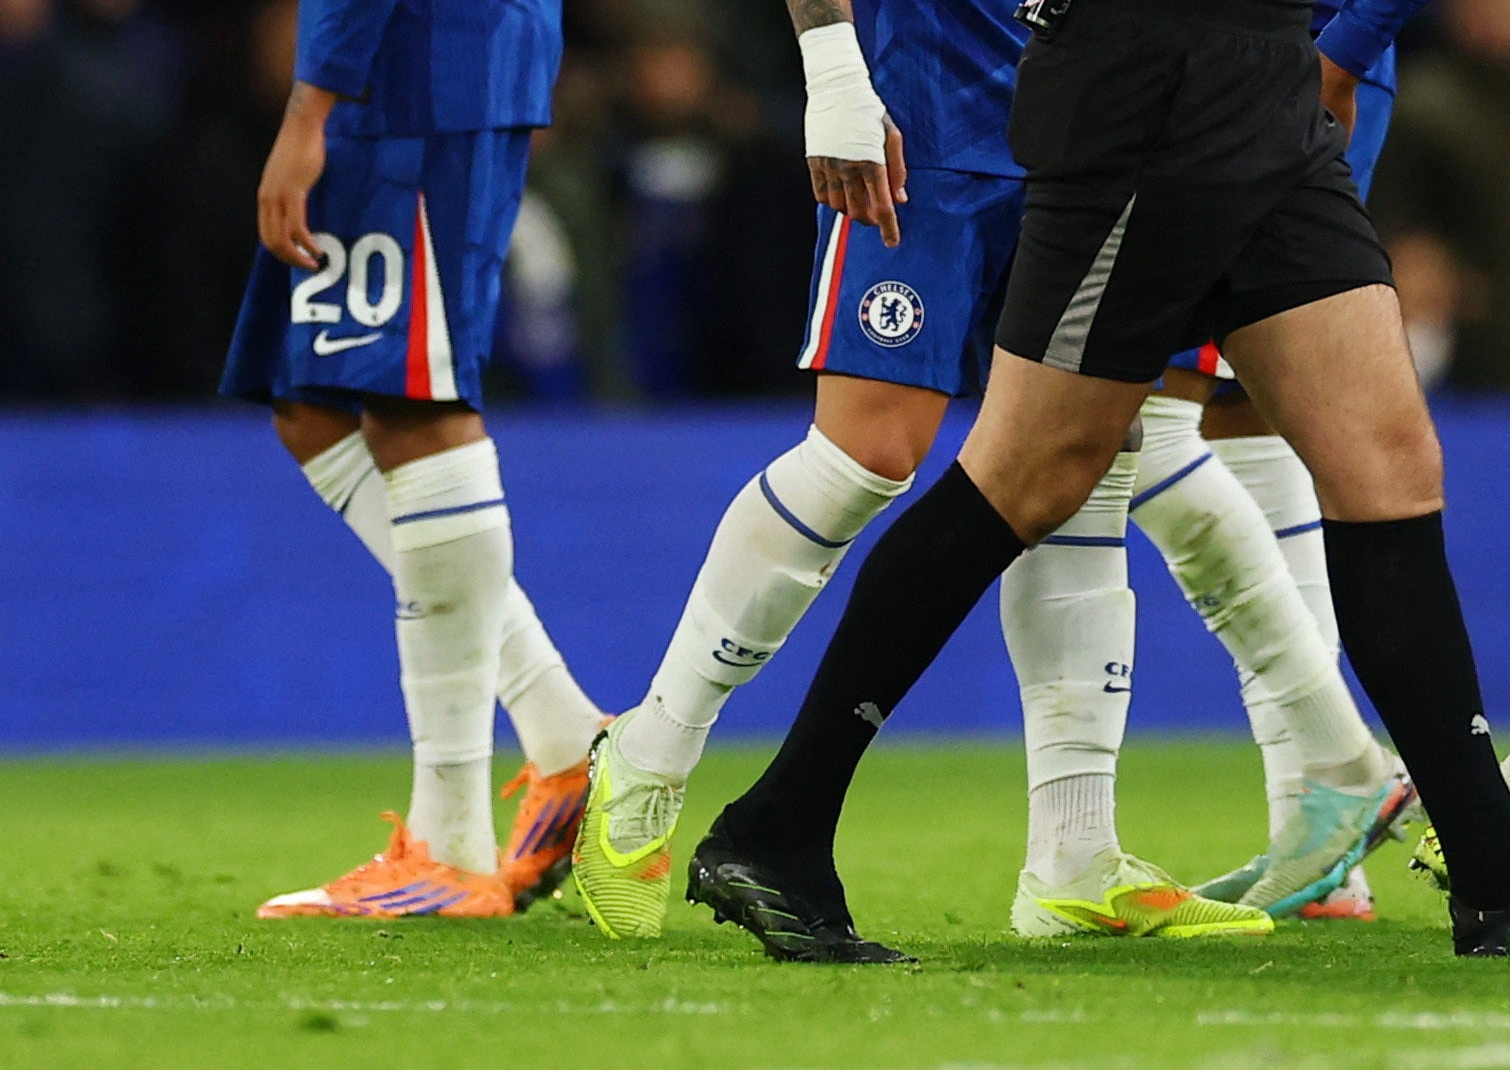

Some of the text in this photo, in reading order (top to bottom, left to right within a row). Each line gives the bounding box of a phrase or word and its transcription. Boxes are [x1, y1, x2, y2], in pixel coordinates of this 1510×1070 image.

[290, 232, 404, 327] 20
[873, 284, 915, 302] CHELSEA
[1104, 661, 1129, 677] CF
